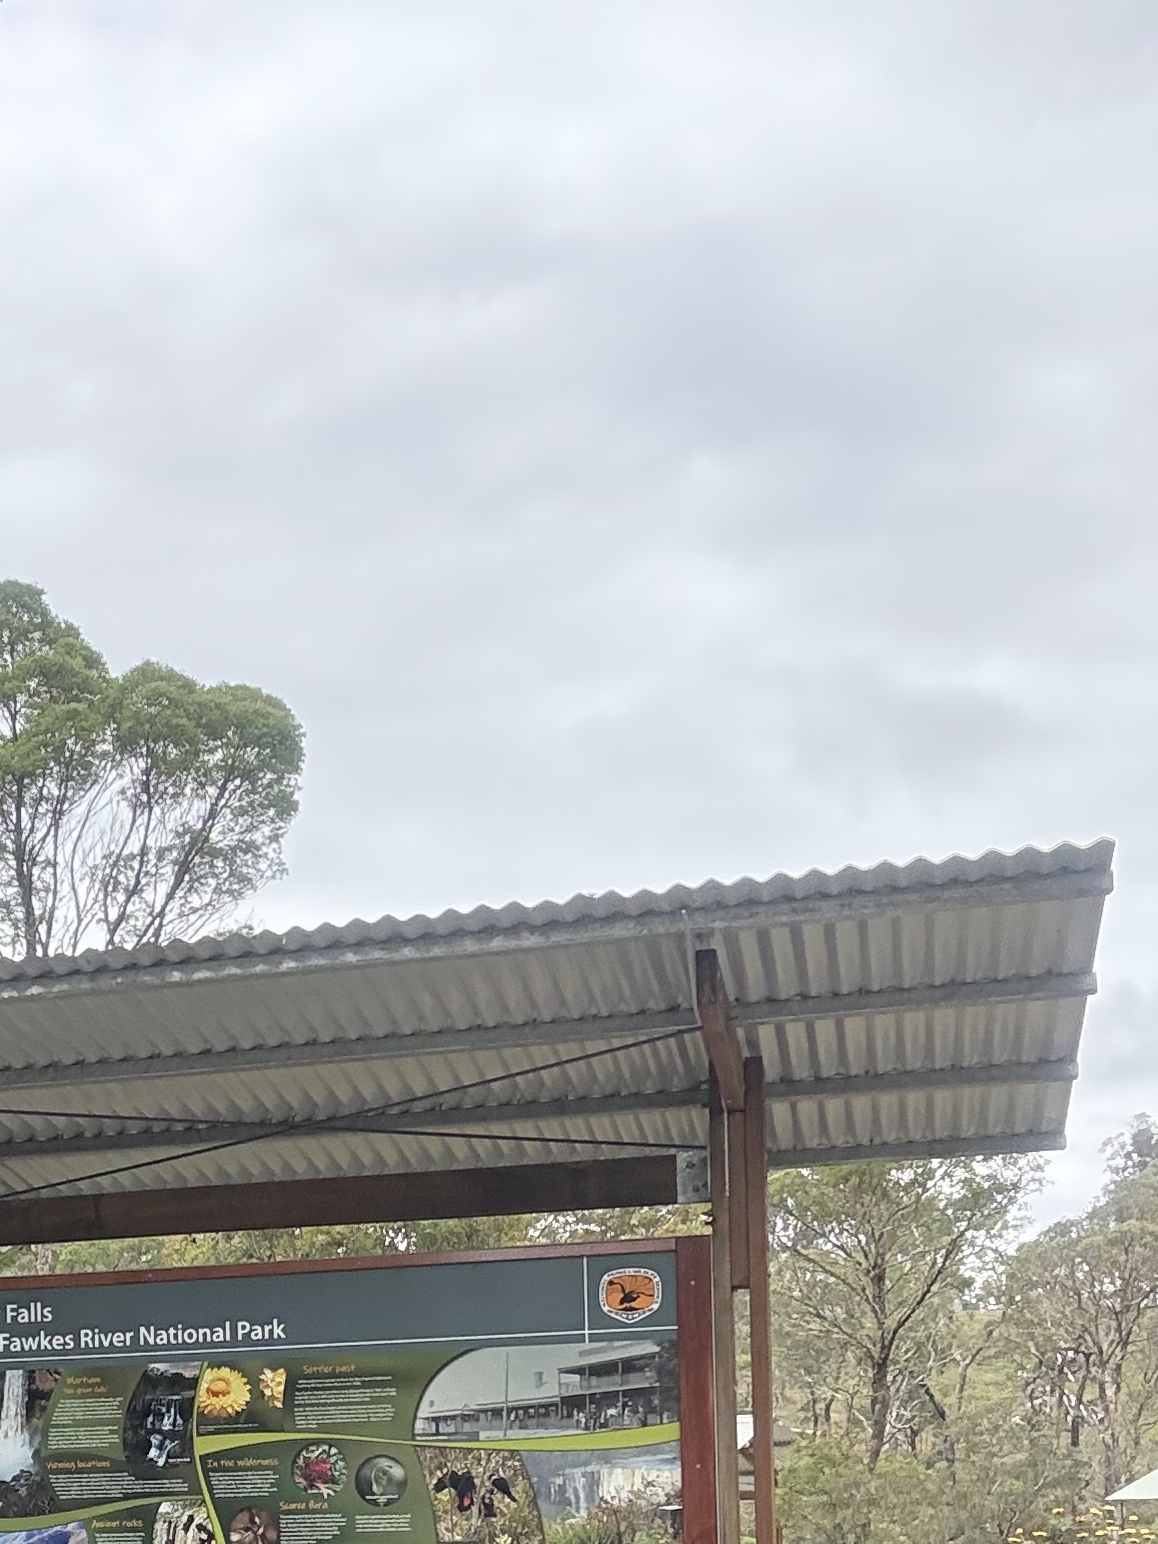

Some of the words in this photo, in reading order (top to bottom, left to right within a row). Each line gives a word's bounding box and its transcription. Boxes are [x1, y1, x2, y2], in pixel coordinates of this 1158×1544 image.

[5, 1301, 53, 1324] Falls
[80, 1328, 135, 1349] River
[138, 1320, 232, 1347] National
[236, 1318, 286, 1341] Park
